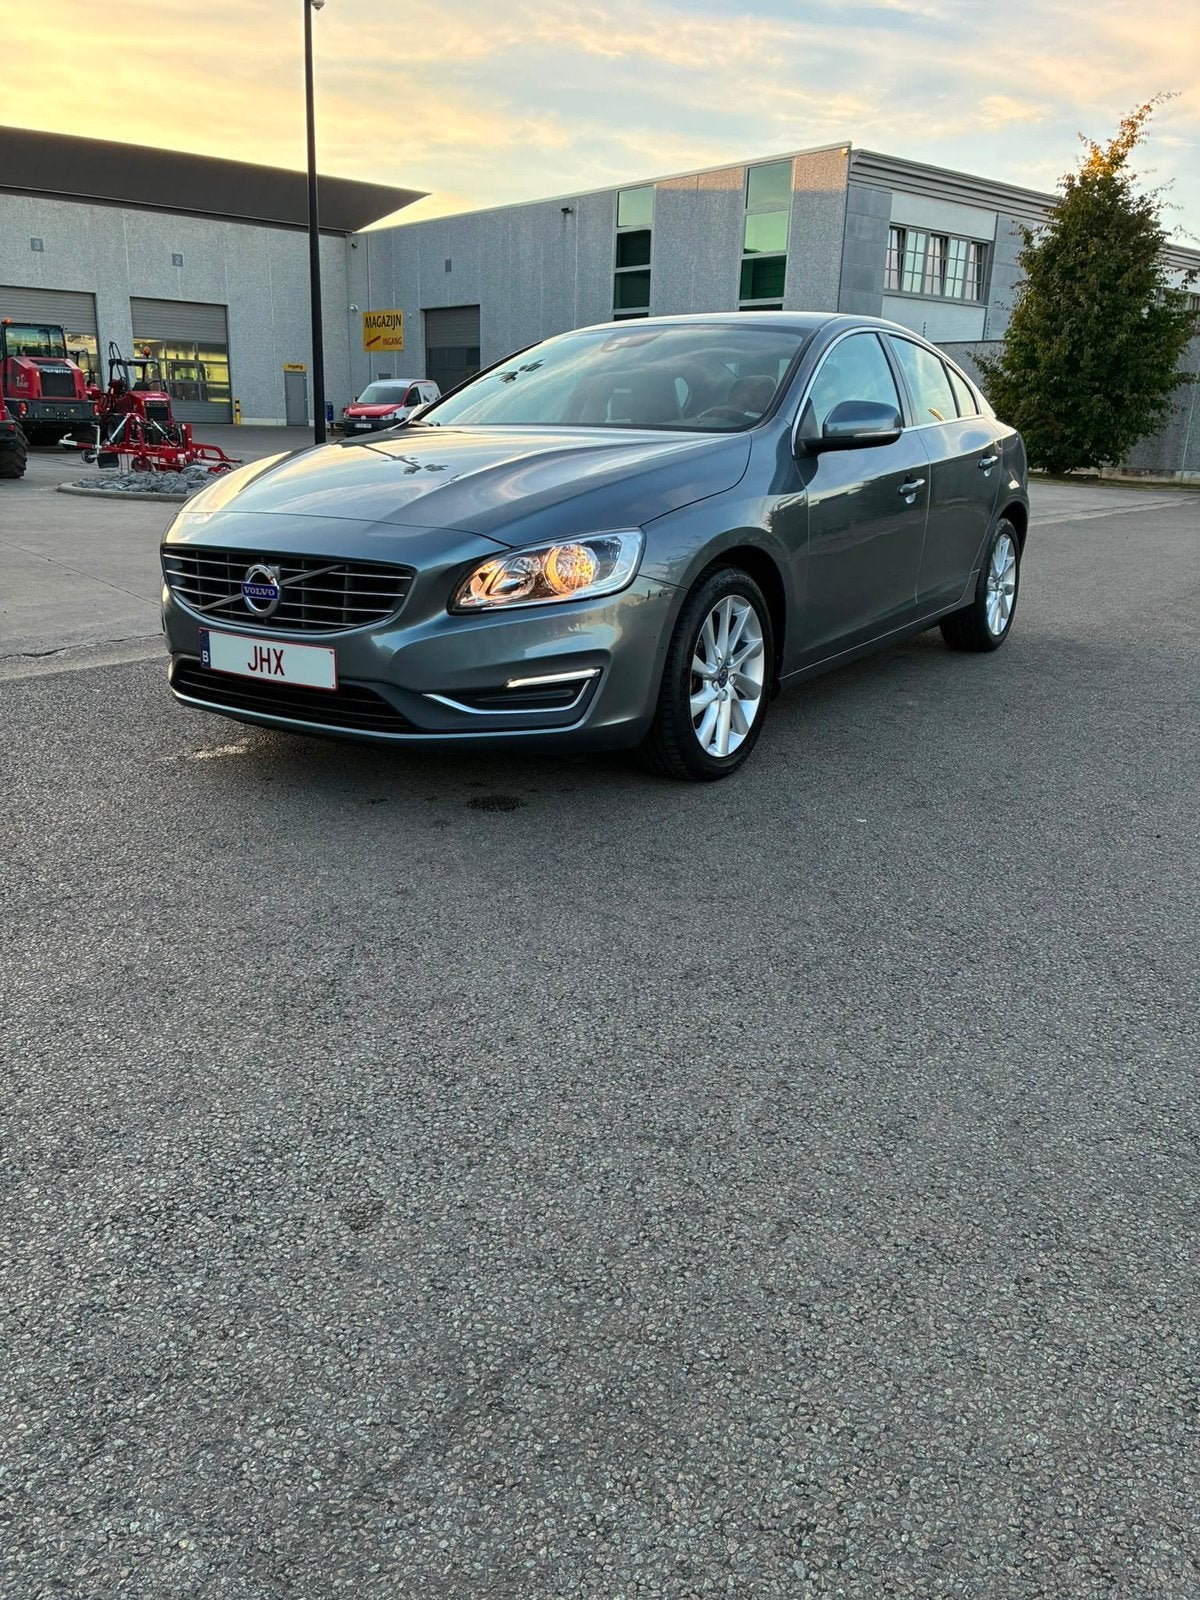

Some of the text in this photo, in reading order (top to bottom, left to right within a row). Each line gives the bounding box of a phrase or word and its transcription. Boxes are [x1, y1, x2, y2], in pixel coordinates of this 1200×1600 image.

[365, 314, 402, 330] MAGAZIJN
[382, 336, 403, 346] INGANG
[243, 586, 275, 597] VOLVO
[202, 650, 209, 663] B
[247, 645, 285, 676] JHX
